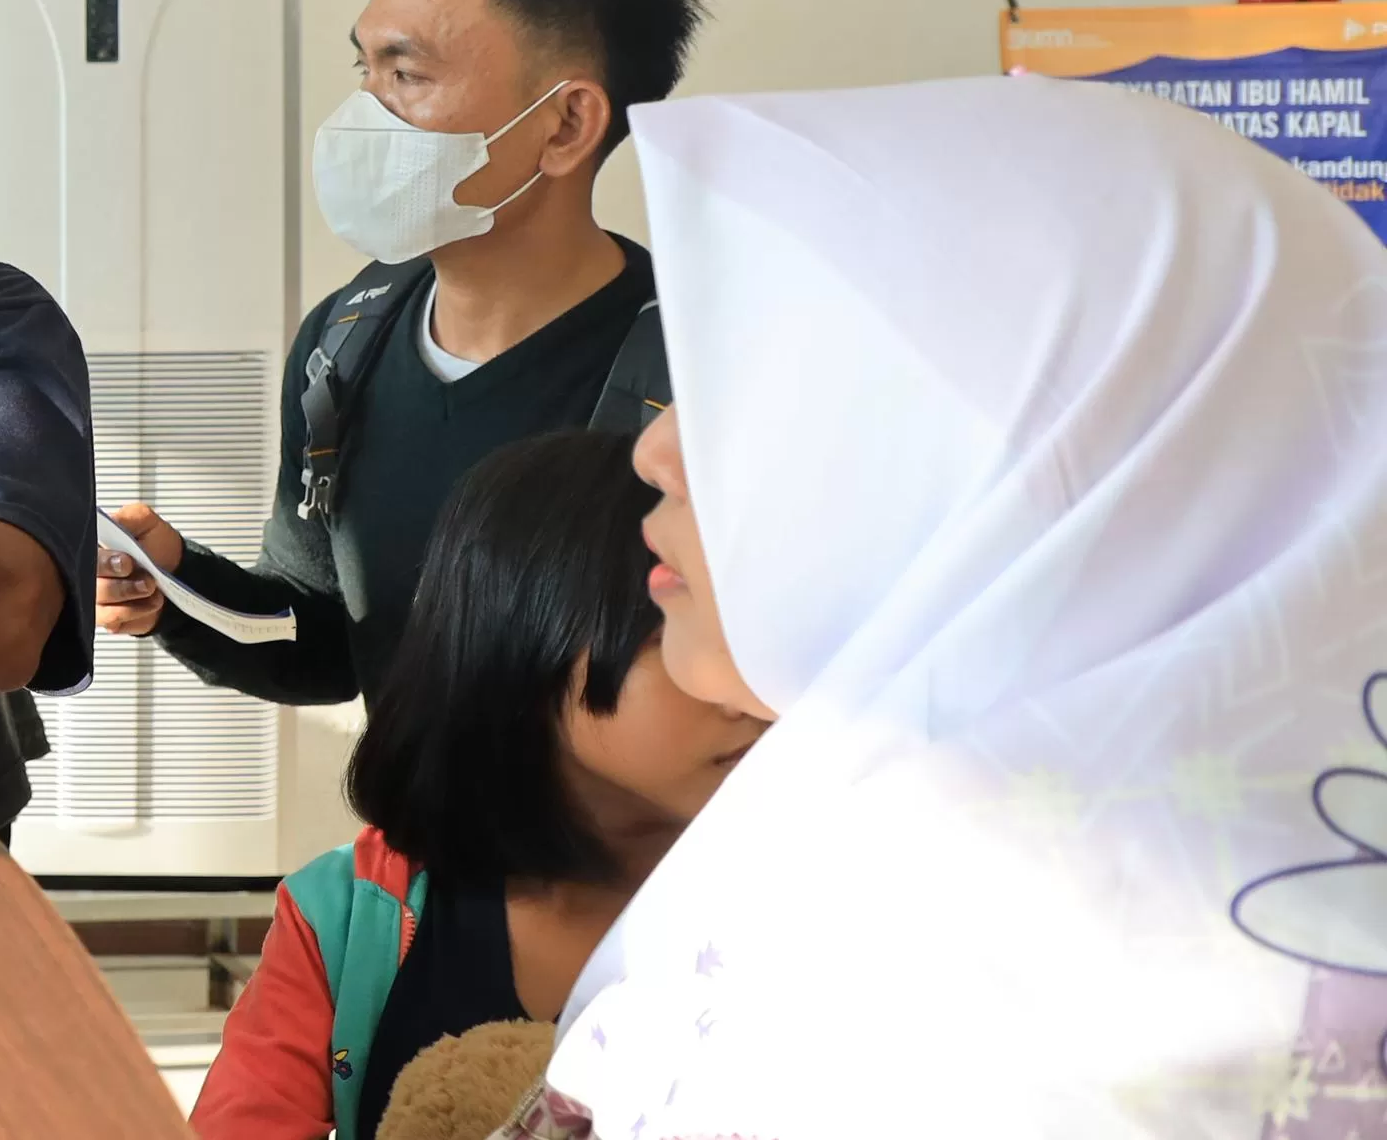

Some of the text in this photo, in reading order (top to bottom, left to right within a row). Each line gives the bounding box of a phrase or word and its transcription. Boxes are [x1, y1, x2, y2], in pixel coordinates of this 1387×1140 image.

[1238, 79, 1281, 106] IBU
[1287, 78, 1370, 106] HAMIL
[1285, 110, 1368, 138] KAPAL
[1291, 155, 1387, 183] kandun
